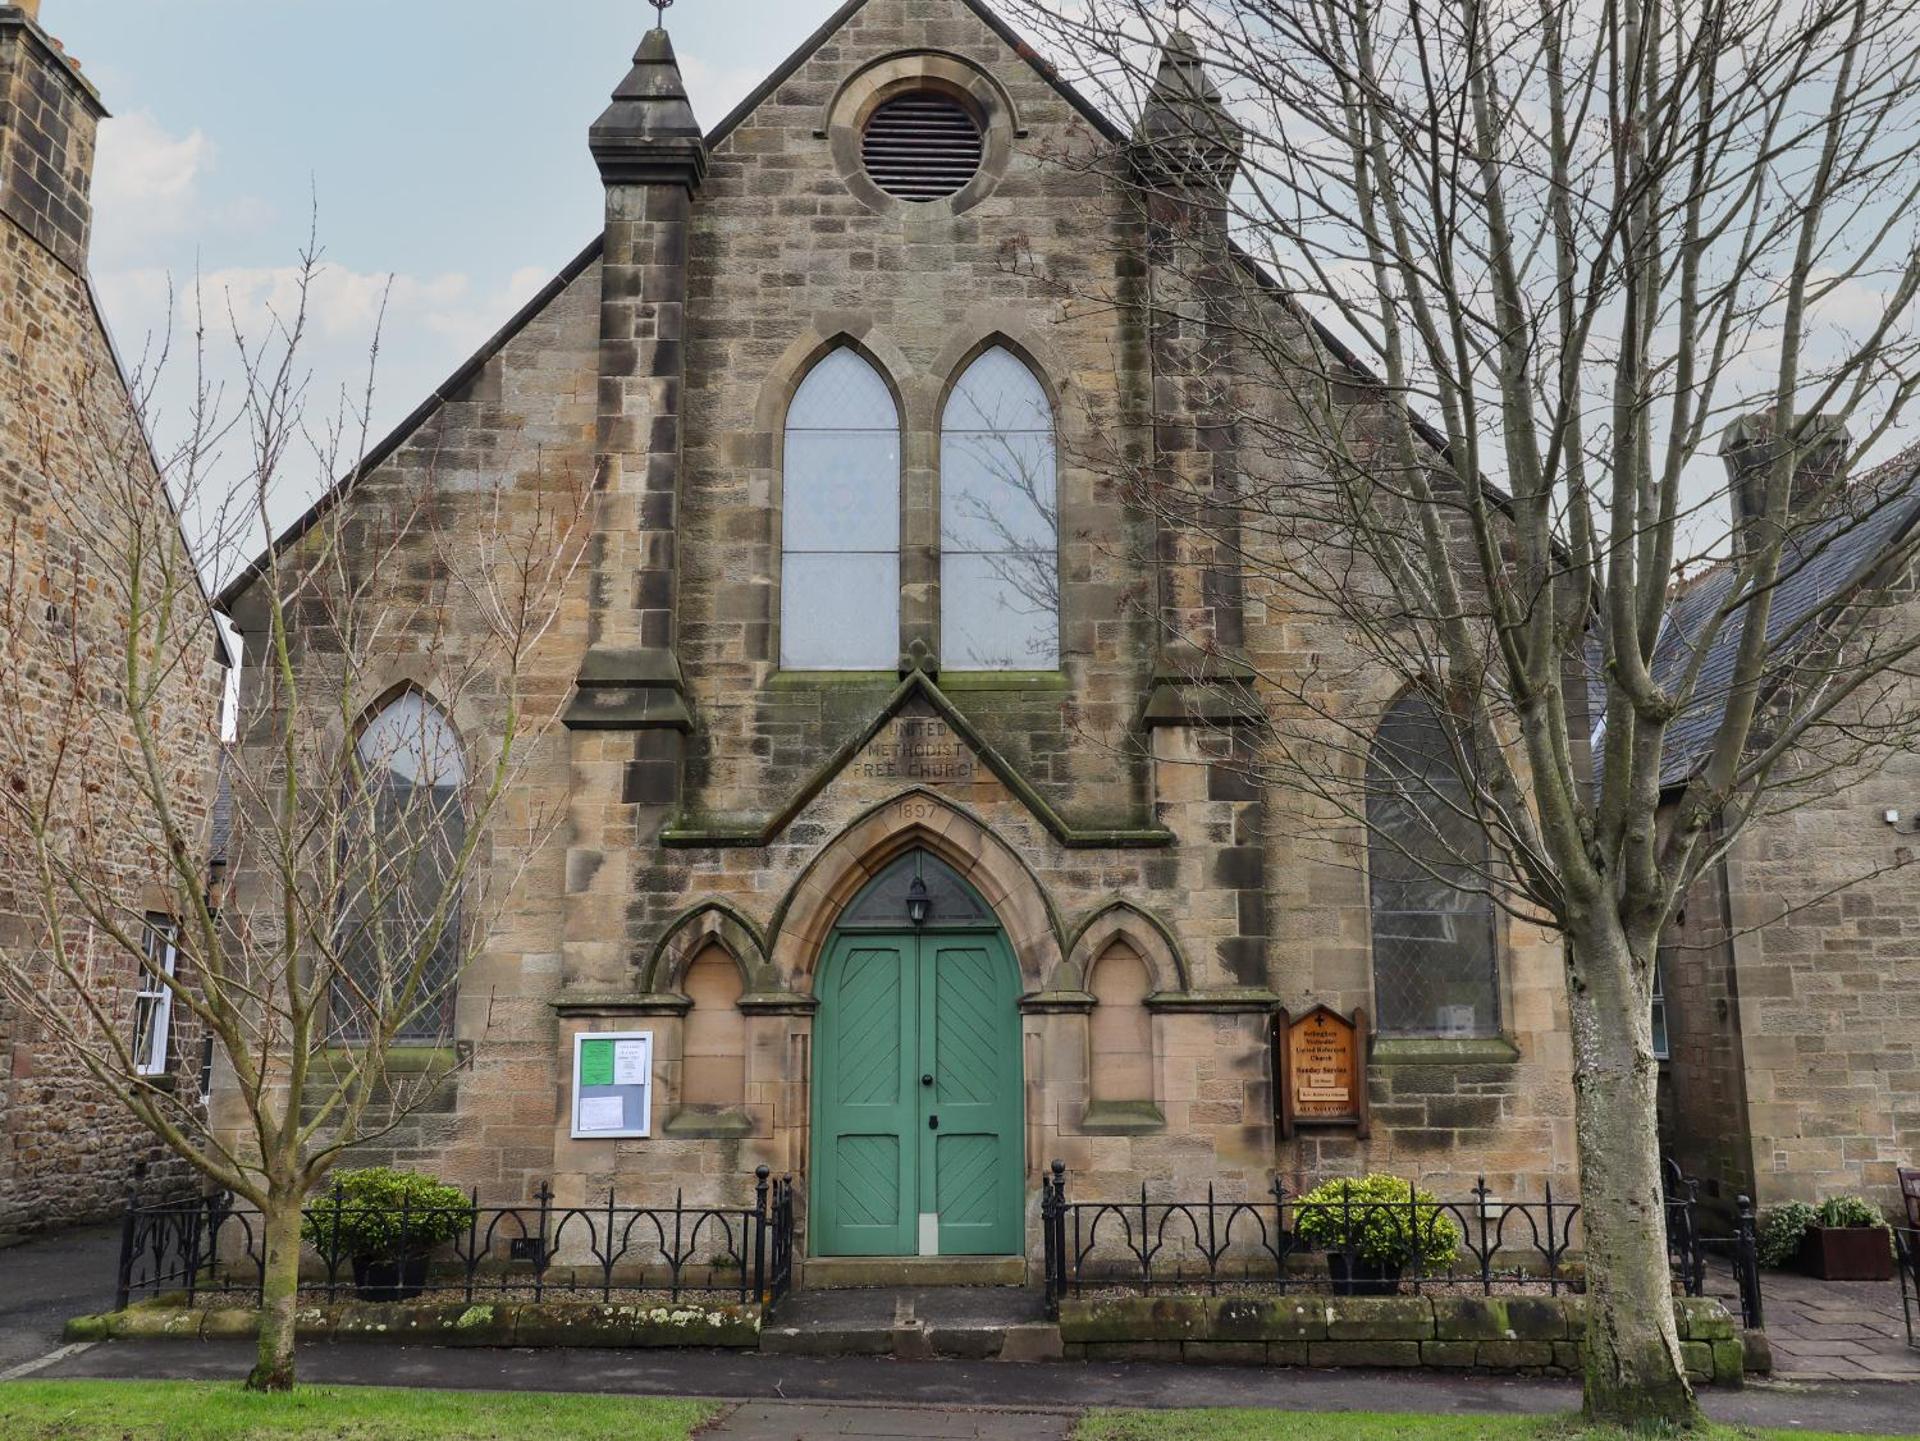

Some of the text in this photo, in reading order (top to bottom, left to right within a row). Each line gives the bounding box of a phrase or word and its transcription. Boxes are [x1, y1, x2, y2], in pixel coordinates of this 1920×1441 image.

[889, 722, 947, 737] UNITED
[868, 743, 963, 757] METHODIST
[853, 763, 981, 777] FREE CHURCH
[899, 804, 937, 818] 1897
